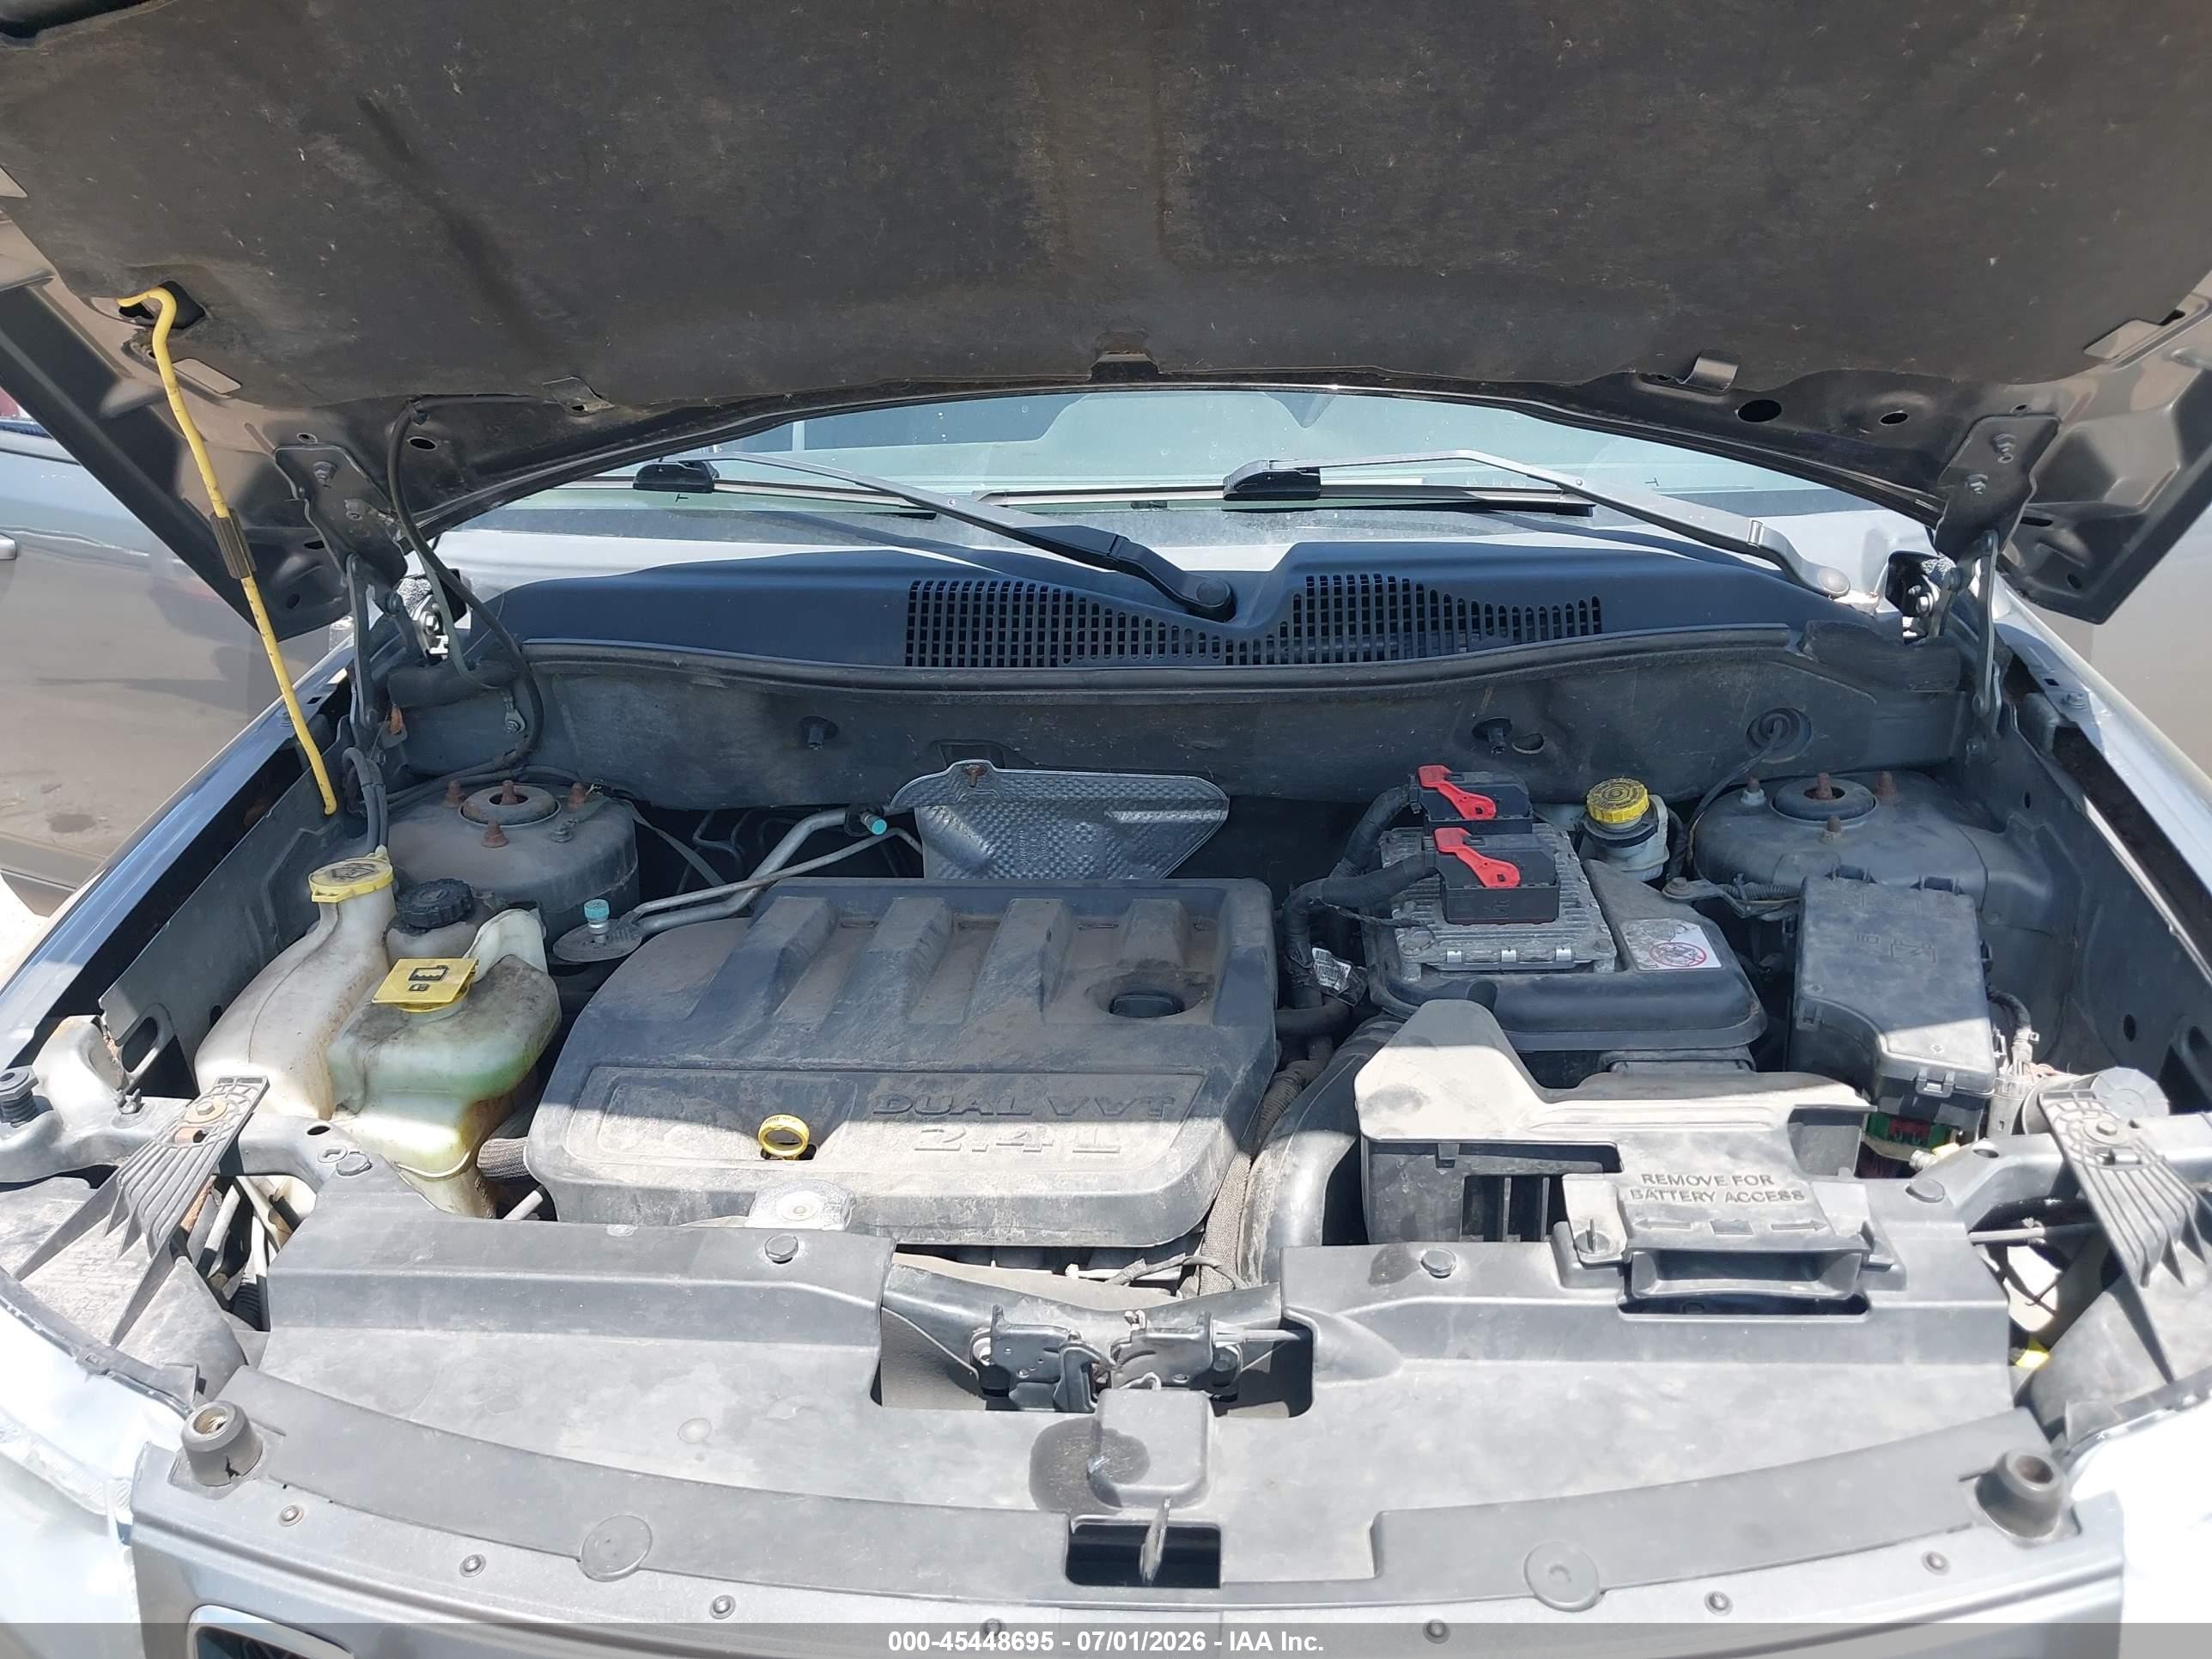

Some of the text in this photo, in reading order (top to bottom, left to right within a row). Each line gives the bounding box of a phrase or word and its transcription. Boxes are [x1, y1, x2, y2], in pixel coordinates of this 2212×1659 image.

[872, 1094, 1176, 1118] DUAL VVT
[1641, 1173, 1774, 1187] REMOVE FOR
[1630, 1188, 1805, 1203] BATTERY ACCESS
